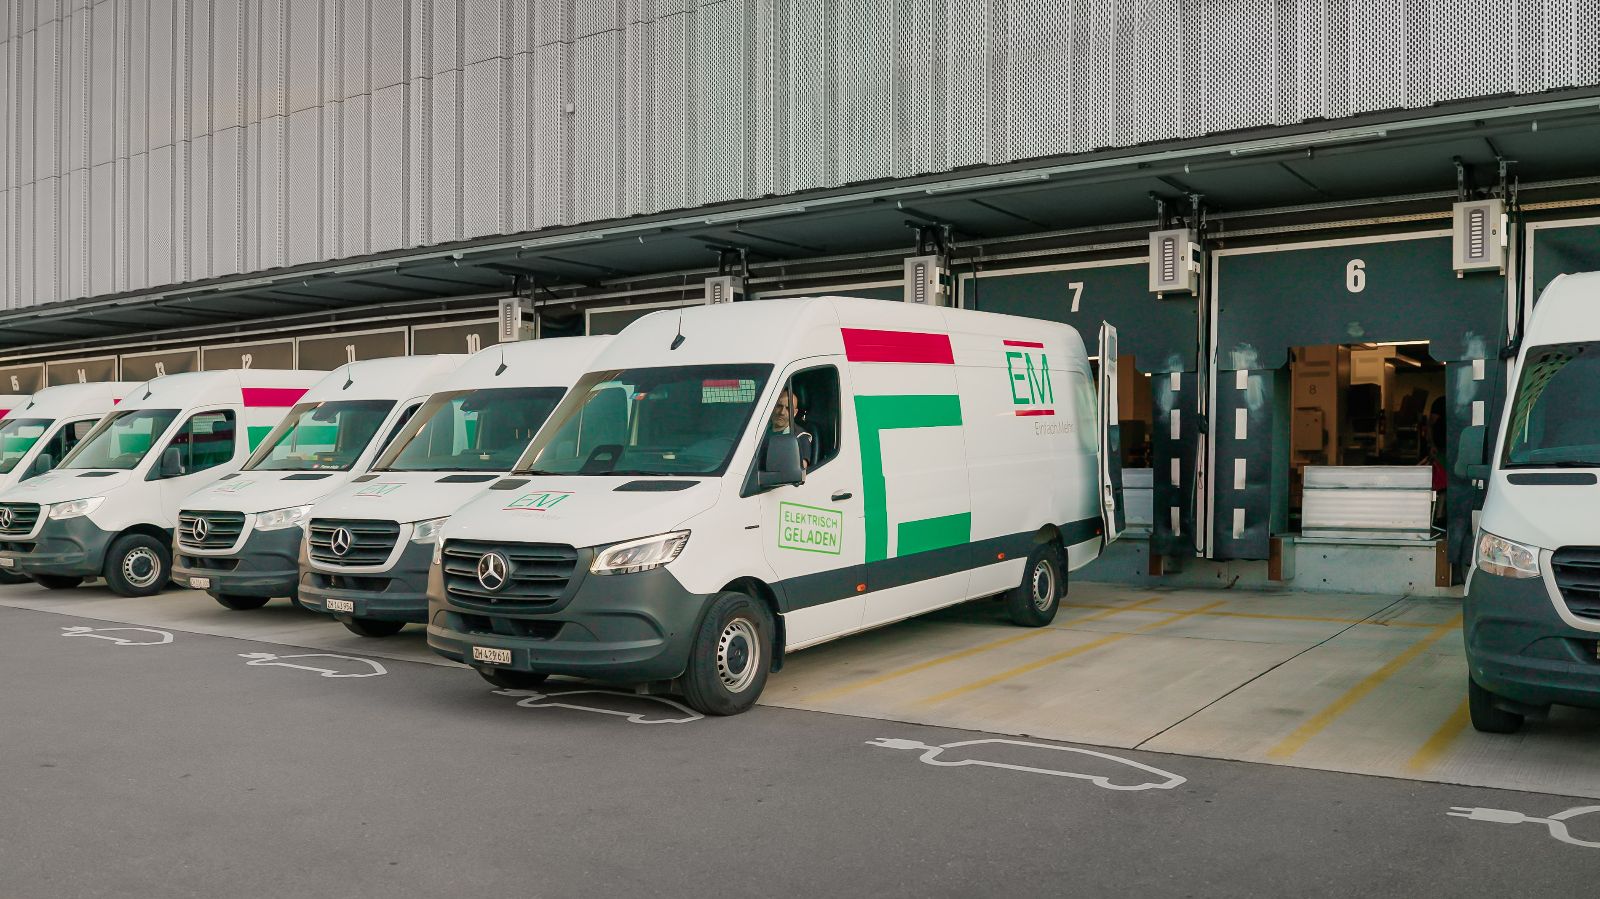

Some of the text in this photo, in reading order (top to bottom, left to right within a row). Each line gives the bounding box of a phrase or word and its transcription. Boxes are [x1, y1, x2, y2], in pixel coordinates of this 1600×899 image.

[1346, 259, 1366, 292] 6
[1068, 281, 1084, 313] 7
[466, 333, 481, 354] 10
[241, 354, 253, 369] 12
[345, 344, 356, 363] 11
[155, 361, 166, 377] 13
[1005, 351, 1054, 405] EM
[1309, 384, 1317, 395] 8
[506, 493, 570, 509] EM
[784, 510, 838, 529] ELEKTRISCH
[784, 526, 837, 547] GELADEN
